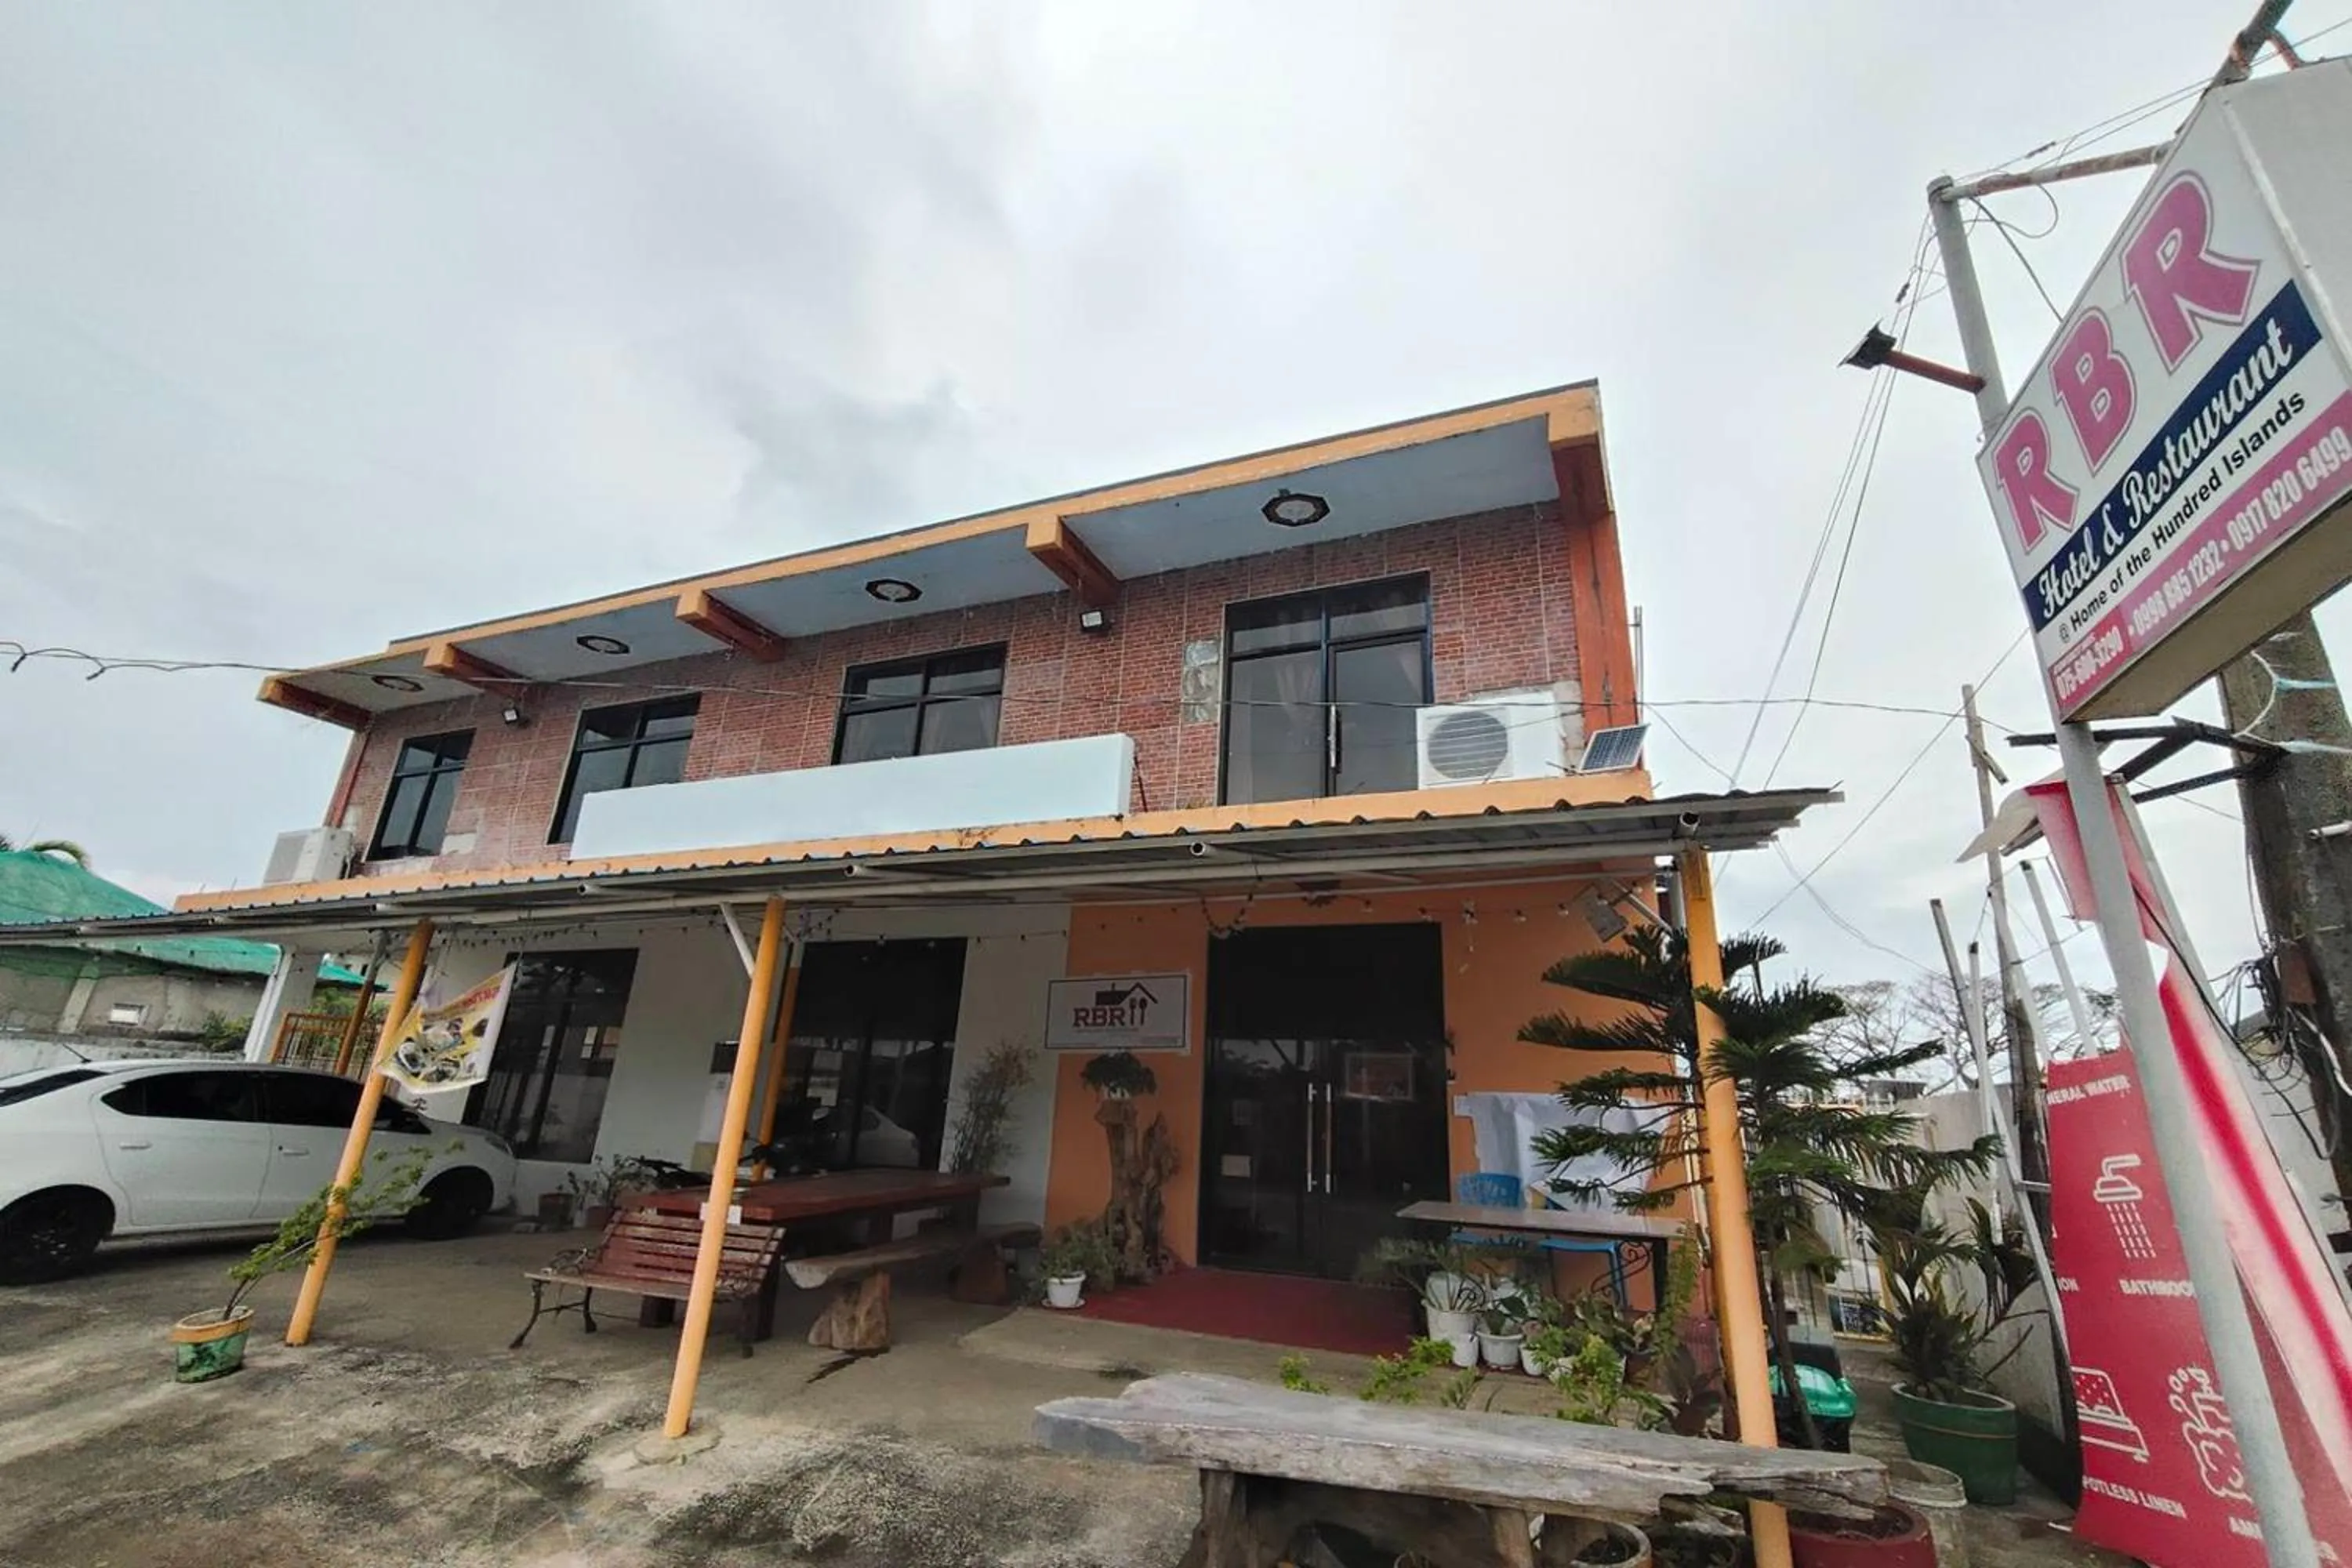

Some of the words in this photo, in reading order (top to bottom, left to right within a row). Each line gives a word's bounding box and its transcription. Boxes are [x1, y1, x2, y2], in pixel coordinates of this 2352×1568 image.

[1992, 170, 2263, 555] RBR
[2039, 527, 2101, 618] Hotel
[2103, 503, 2125, 554] &
[2122, 318, 2292, 528] Restaurant
[2070, 591, 2107, 632] Home
[2110, 568, 2125, 593] of
[2126, 547, 2151, 576] the
[2151, 467, 2222, 550] Hundred
[2222, 393, 2305, 476] Islands
[2187, 539, 2226, 588] 1232
[2227, 498, 2268, 551] 0917
[2262, 470, 2303, 521] 820
[2296, 426, 2352, 491] 6499
[1073, 1007, 1126, 1028] RBR
[2119, 1279, 2197, 1297] BATHROO
[2082, 1475, 2140, 1504] POTLESS
